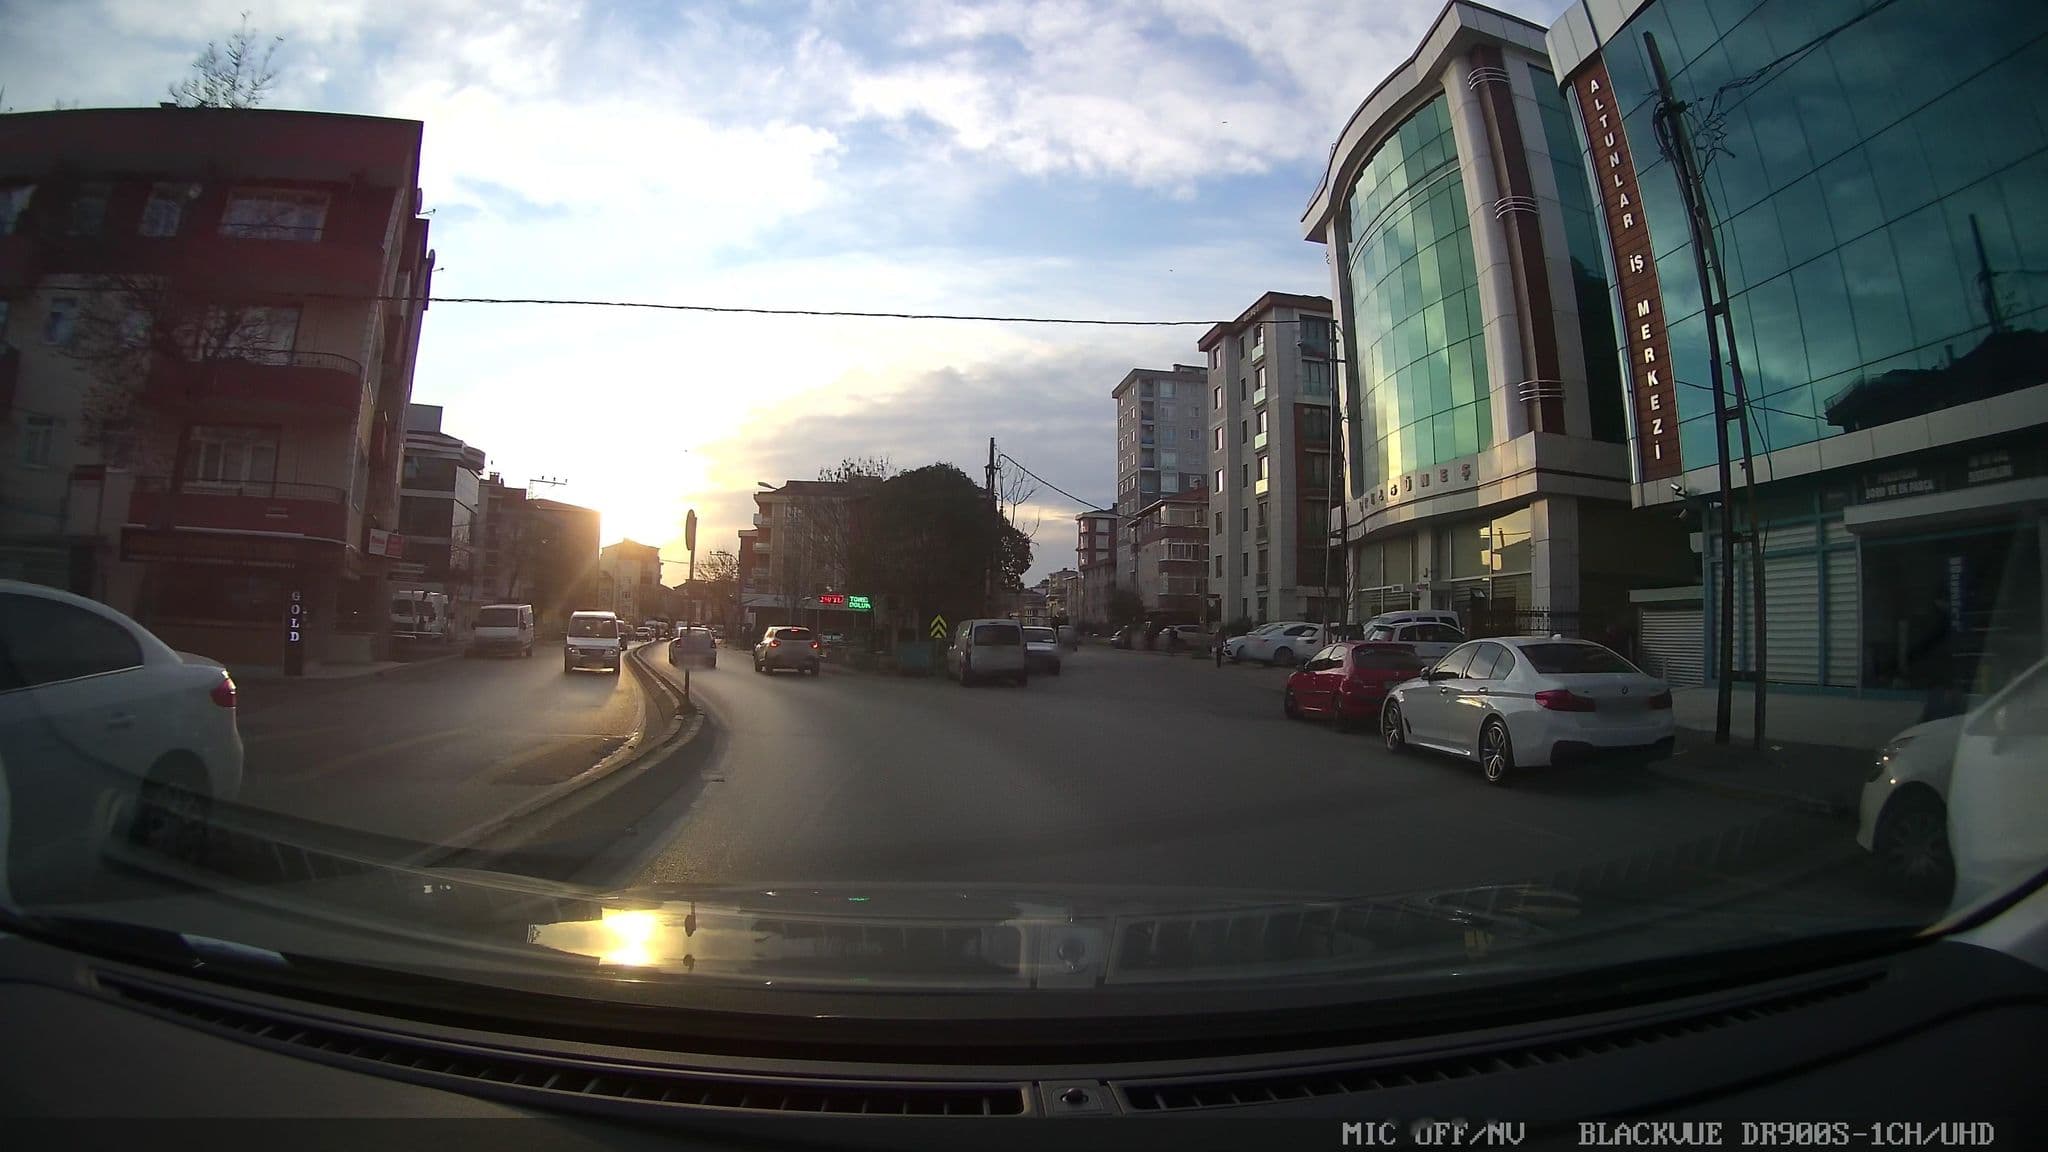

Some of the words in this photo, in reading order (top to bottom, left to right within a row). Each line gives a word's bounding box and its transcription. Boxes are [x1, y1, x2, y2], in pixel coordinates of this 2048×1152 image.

[1590, 79, 1633, 229] ALTUNLAR
[1629, 254, 1644, 274] İŞ
[1637, 299, 1663, 460] MERKEZİ
[290, 591, 301, 642] GOLD
